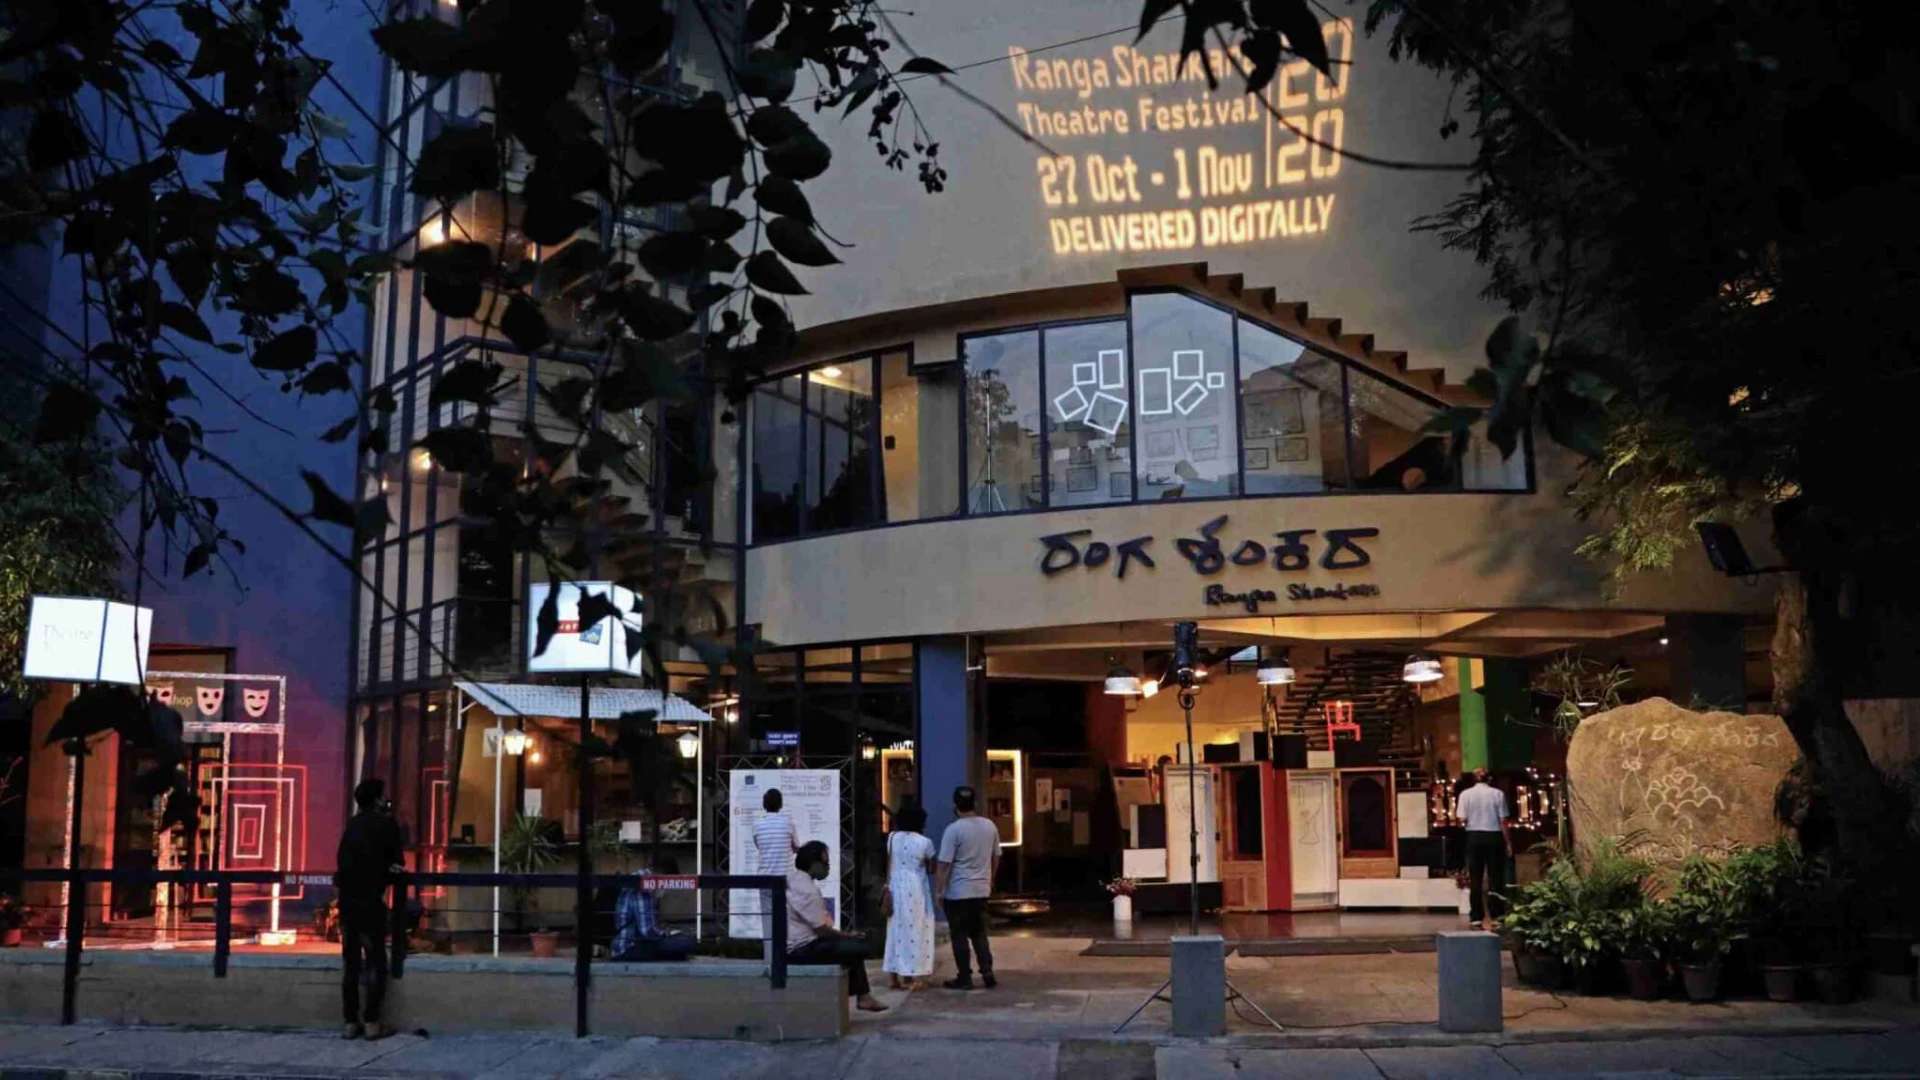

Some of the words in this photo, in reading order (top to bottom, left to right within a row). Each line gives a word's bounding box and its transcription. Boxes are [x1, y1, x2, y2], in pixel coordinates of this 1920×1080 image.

[1009, 46, 1108, 98] Ranga
[1017, 102, 1129, 136] Theatre
[1139, 92, 1259, 132] Festival
[1277, 108, 1345, 184] 20
[1037, 154, 1078, 205] 27
[1087, 154, 1142, 202] Oct
[1173, 147, 1191, 200] 1
[1198, 146, 1253, 195] Nov
[1049, 209, 1197, 255] DELIVERED
[1201, 194, 1336, 247] DIGITALLY
[643, 879, 656, 889] NO
[658, 879, 696, 889] PARKING
